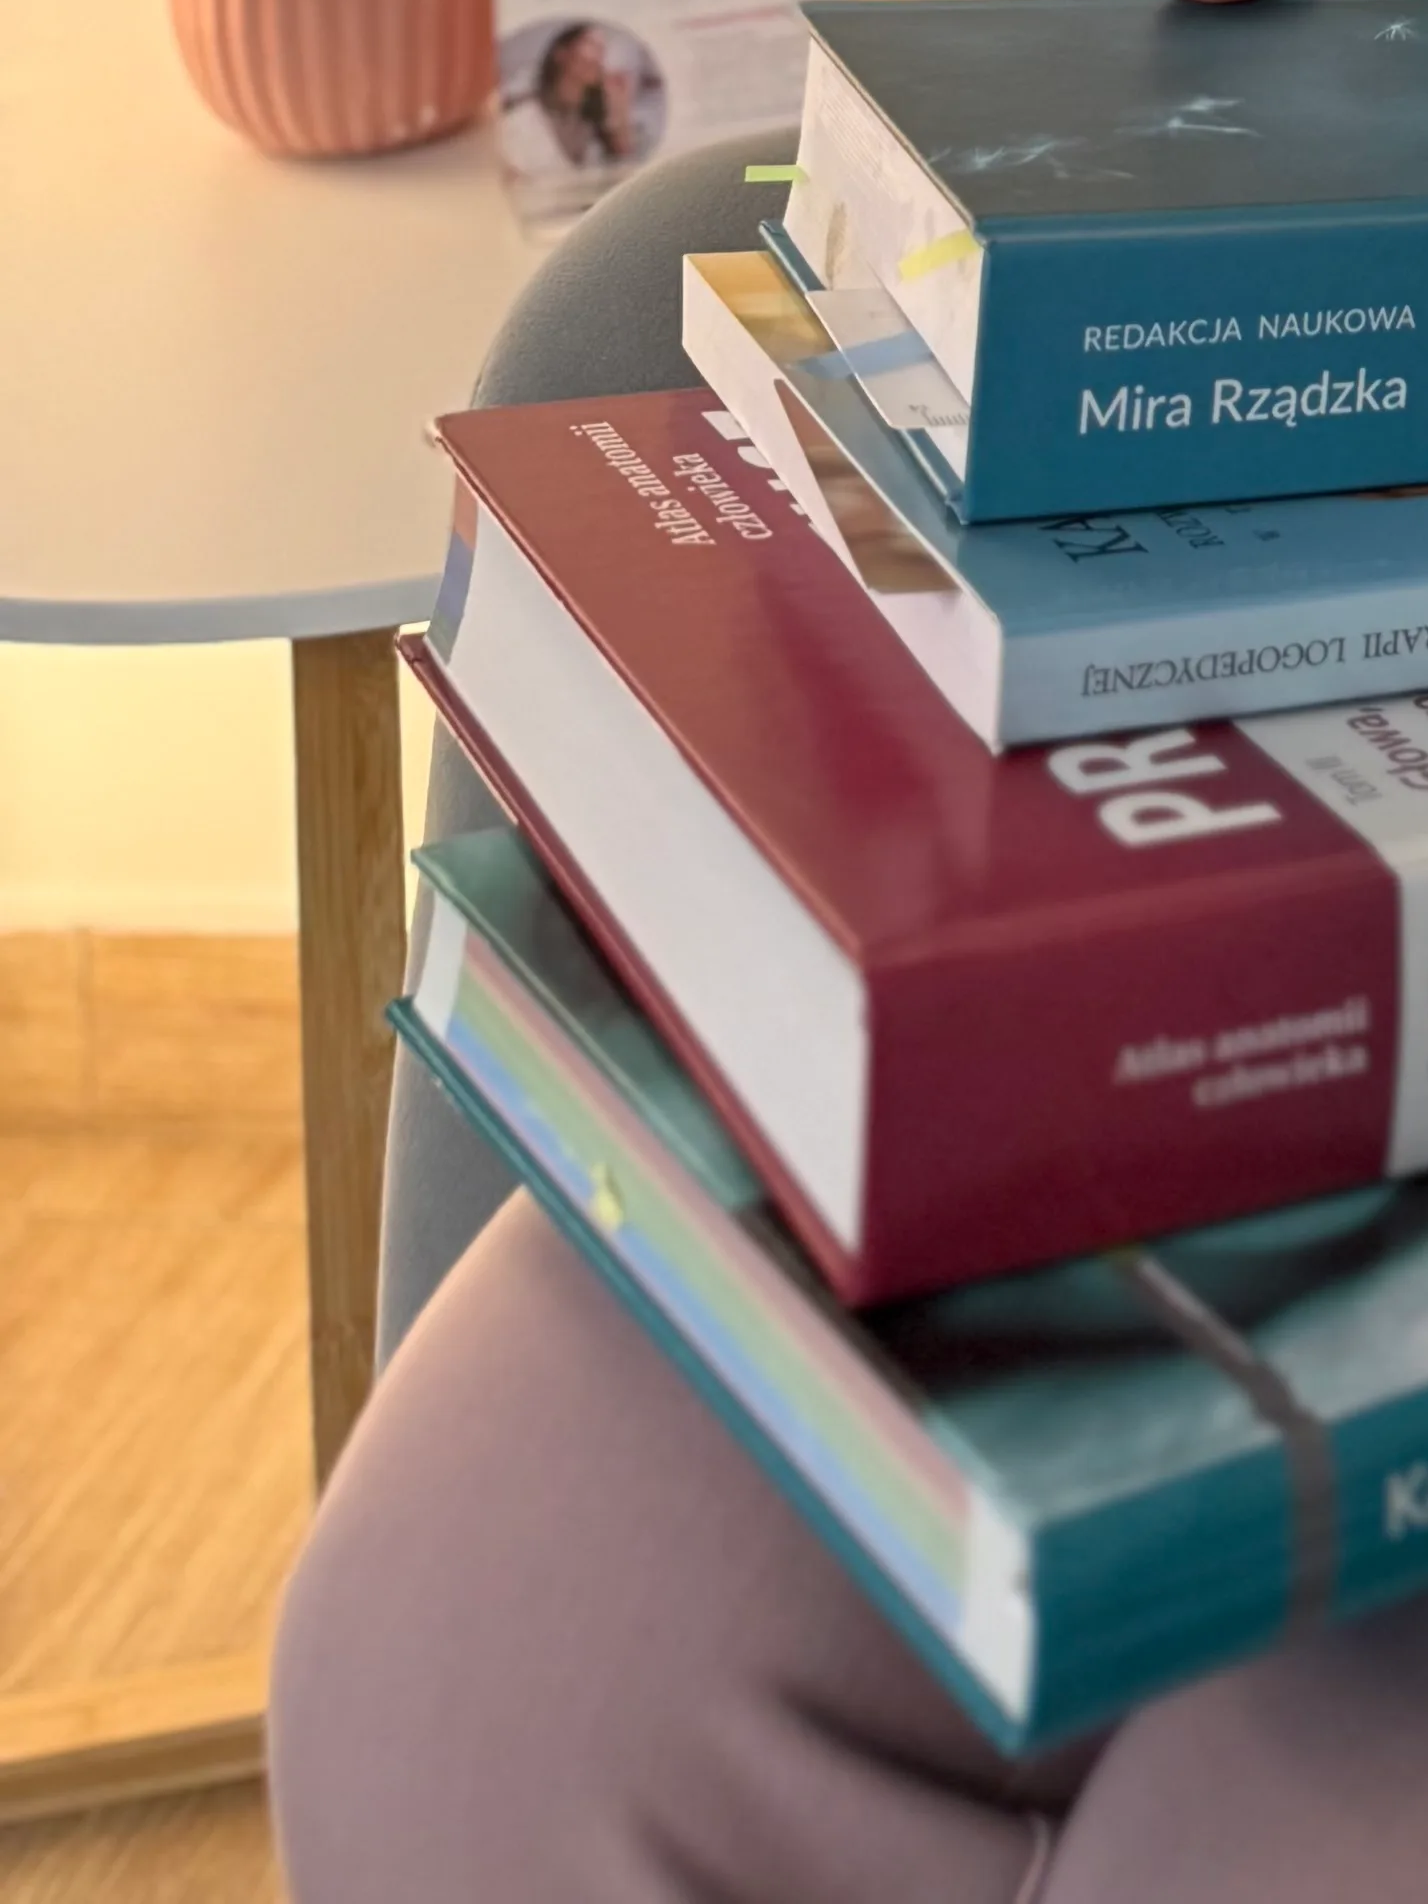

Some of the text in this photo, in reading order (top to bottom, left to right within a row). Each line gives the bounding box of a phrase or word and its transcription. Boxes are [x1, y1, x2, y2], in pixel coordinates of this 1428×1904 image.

[1083, 304, 1416, 351] REDAKCJA NAUKOWA
[1078, 367, 1408, 434] Mira Rządzka
[569, 420, 666, 498] anatomii
[651, 496, 716, 545] Atlas
[1081, 636, 1347, 696] LOGOPEDYCZNEJ
[1047, 729, 1281, 849] PR
